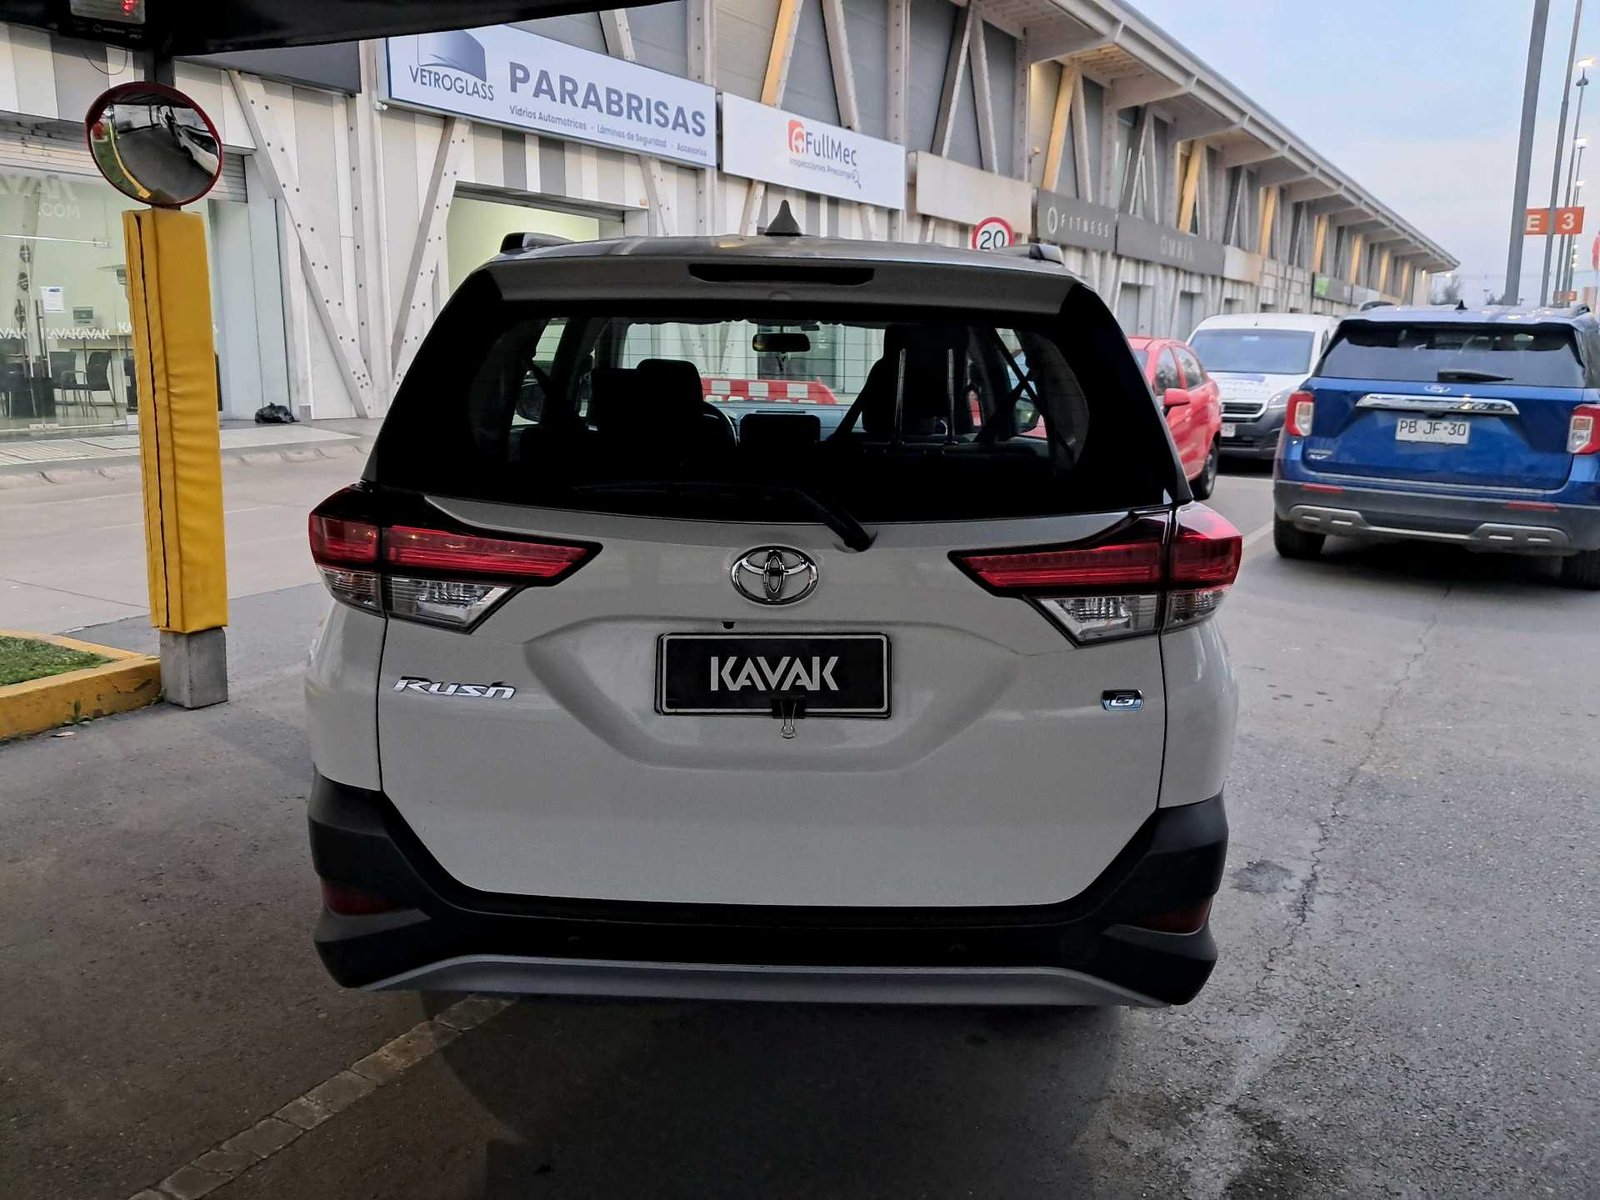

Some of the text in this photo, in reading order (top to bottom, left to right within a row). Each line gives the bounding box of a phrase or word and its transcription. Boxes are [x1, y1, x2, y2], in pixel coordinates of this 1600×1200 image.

[408, 65, 495, 101] VETROGLASS
[508, 61, 707, 137] PARABRISAS
[508, 104, 537, 119] Vidrios
[537, 112, 587, 131] Automotrices
[635, 132, 668, 148] Seguridad
[804, 131, 858, 167] FullMec
[1525, 212, 1575, 232] E 3
[979, 230, 1006, 250] 20
[1399, 420, 1418, 434] PB
[393, 676, 517, 700] Rush
[710, 656, 839, 691] KAVAK
